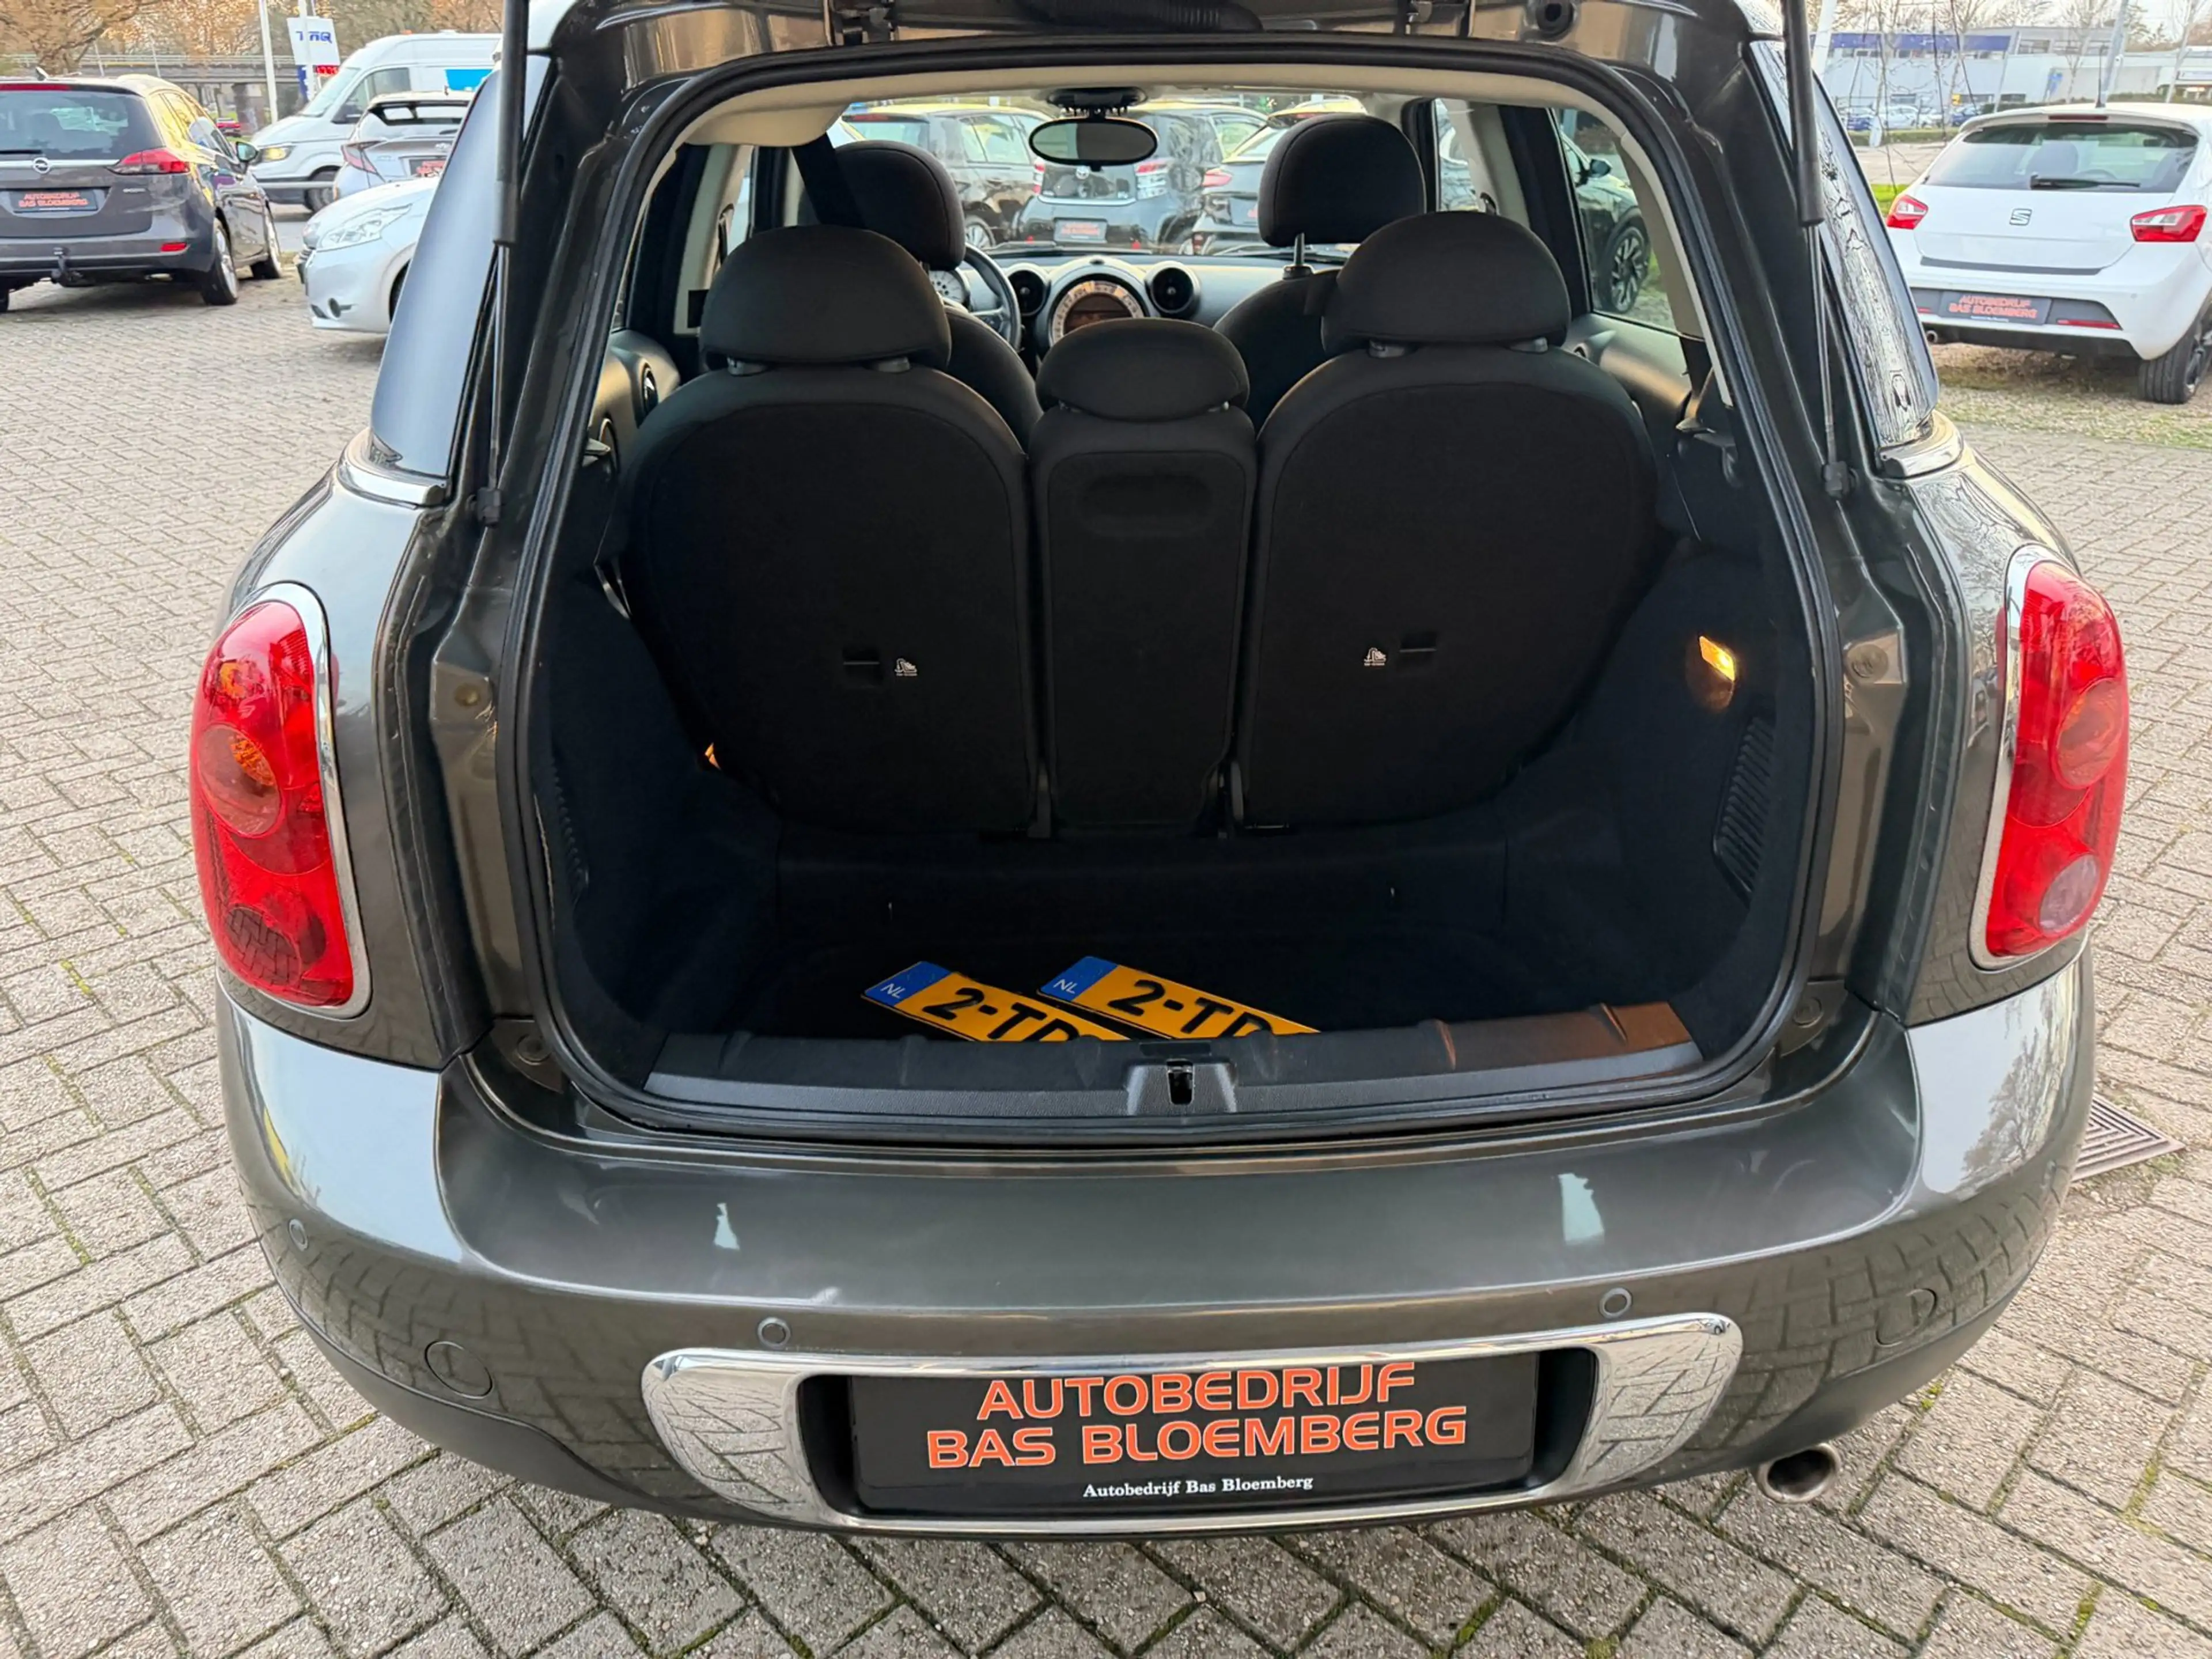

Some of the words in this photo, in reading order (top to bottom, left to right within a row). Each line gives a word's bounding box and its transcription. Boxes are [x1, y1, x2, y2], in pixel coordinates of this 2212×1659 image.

[880, 983, 906, 999] NL
[1053, 979, 1078, 995] NL
[976, 1361, 1415, 1421] AUTOBEDRIJF
[927, 1427, 1056, 1469] BAS
[1082, 1406, 1467, 1465] BLOEMBERG
[1083, 1480, 1181, 1498] Autobedrijf
[1185, 1479, 1216, 1494] Bas
[1221, 1476, 1313, 1492] Bloemberg
